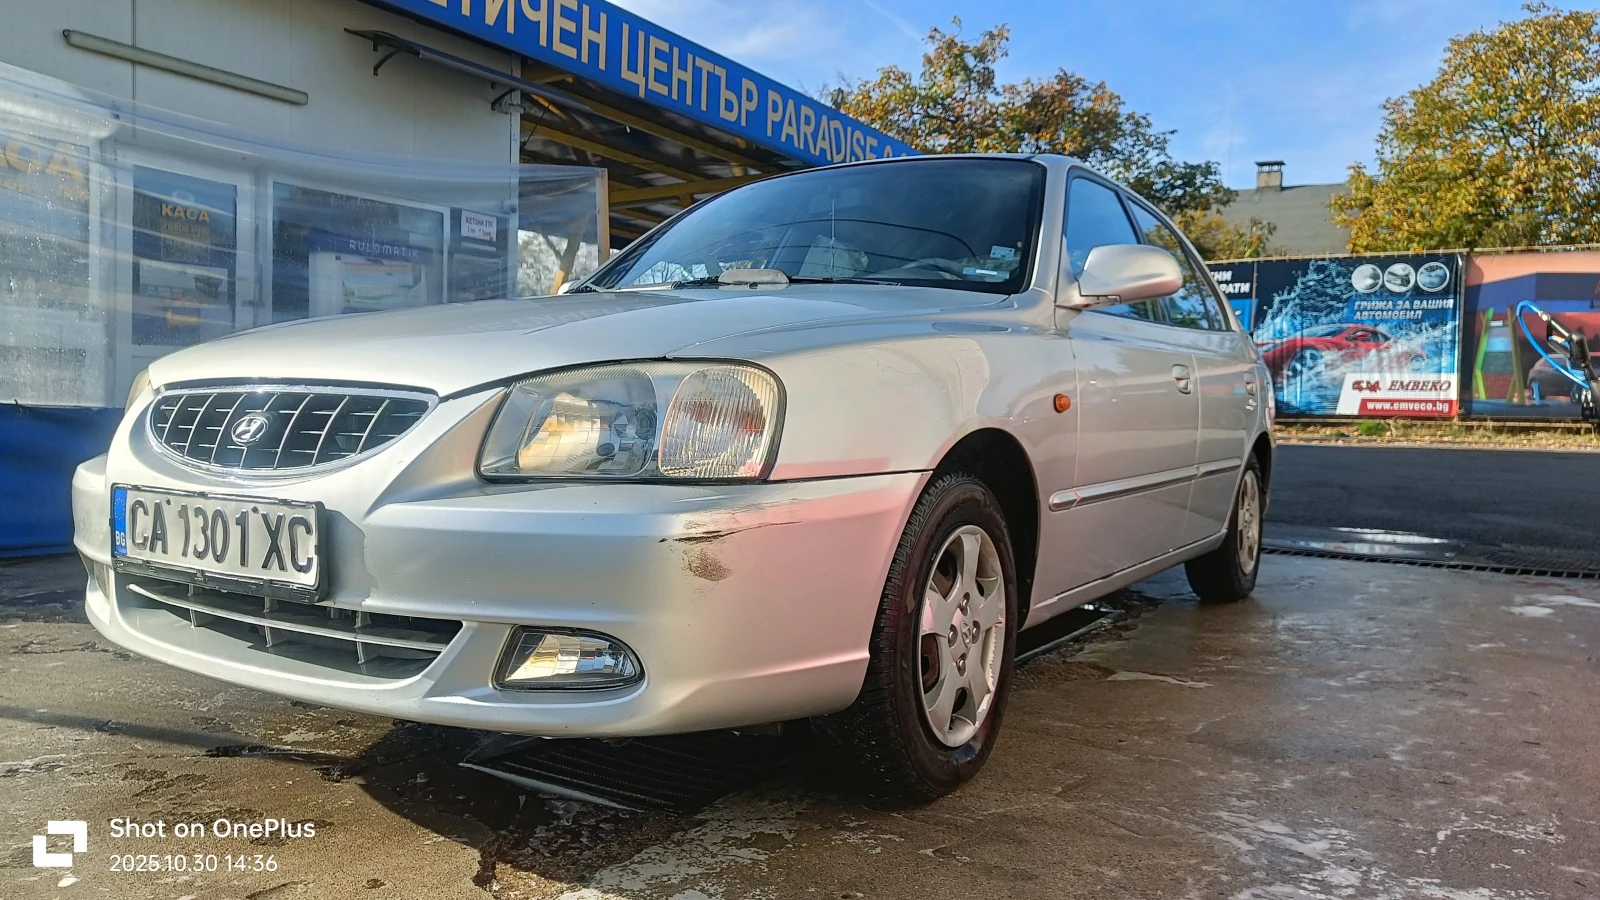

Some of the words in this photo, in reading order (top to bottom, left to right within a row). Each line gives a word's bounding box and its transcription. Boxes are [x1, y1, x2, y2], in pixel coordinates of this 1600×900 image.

[426, 0, 608, 71] ИЧЕН
[621, 22, 759, 127] ЦЕНТЪР
[766, 89, 879, 163] PARADISE
[0, 140, 84, 180] СА
[161, 203, 210, 222] КАСА
[1354, 300, 1393, 311] ГРИЖА
[1396, 300, 1411, 310] ЗА
[1412, 298, 1454, 310] ВАШИЯ
[1354, 310, 1423, 320] АВТОМОБИЛ
[1388, 380, 1452, 392] ЕМВЕКО
[1366, 401, 1450, 413] www.emveco.bg
[115, 530, 126, 546] BG
[177, 503, 249, 567] 1301
